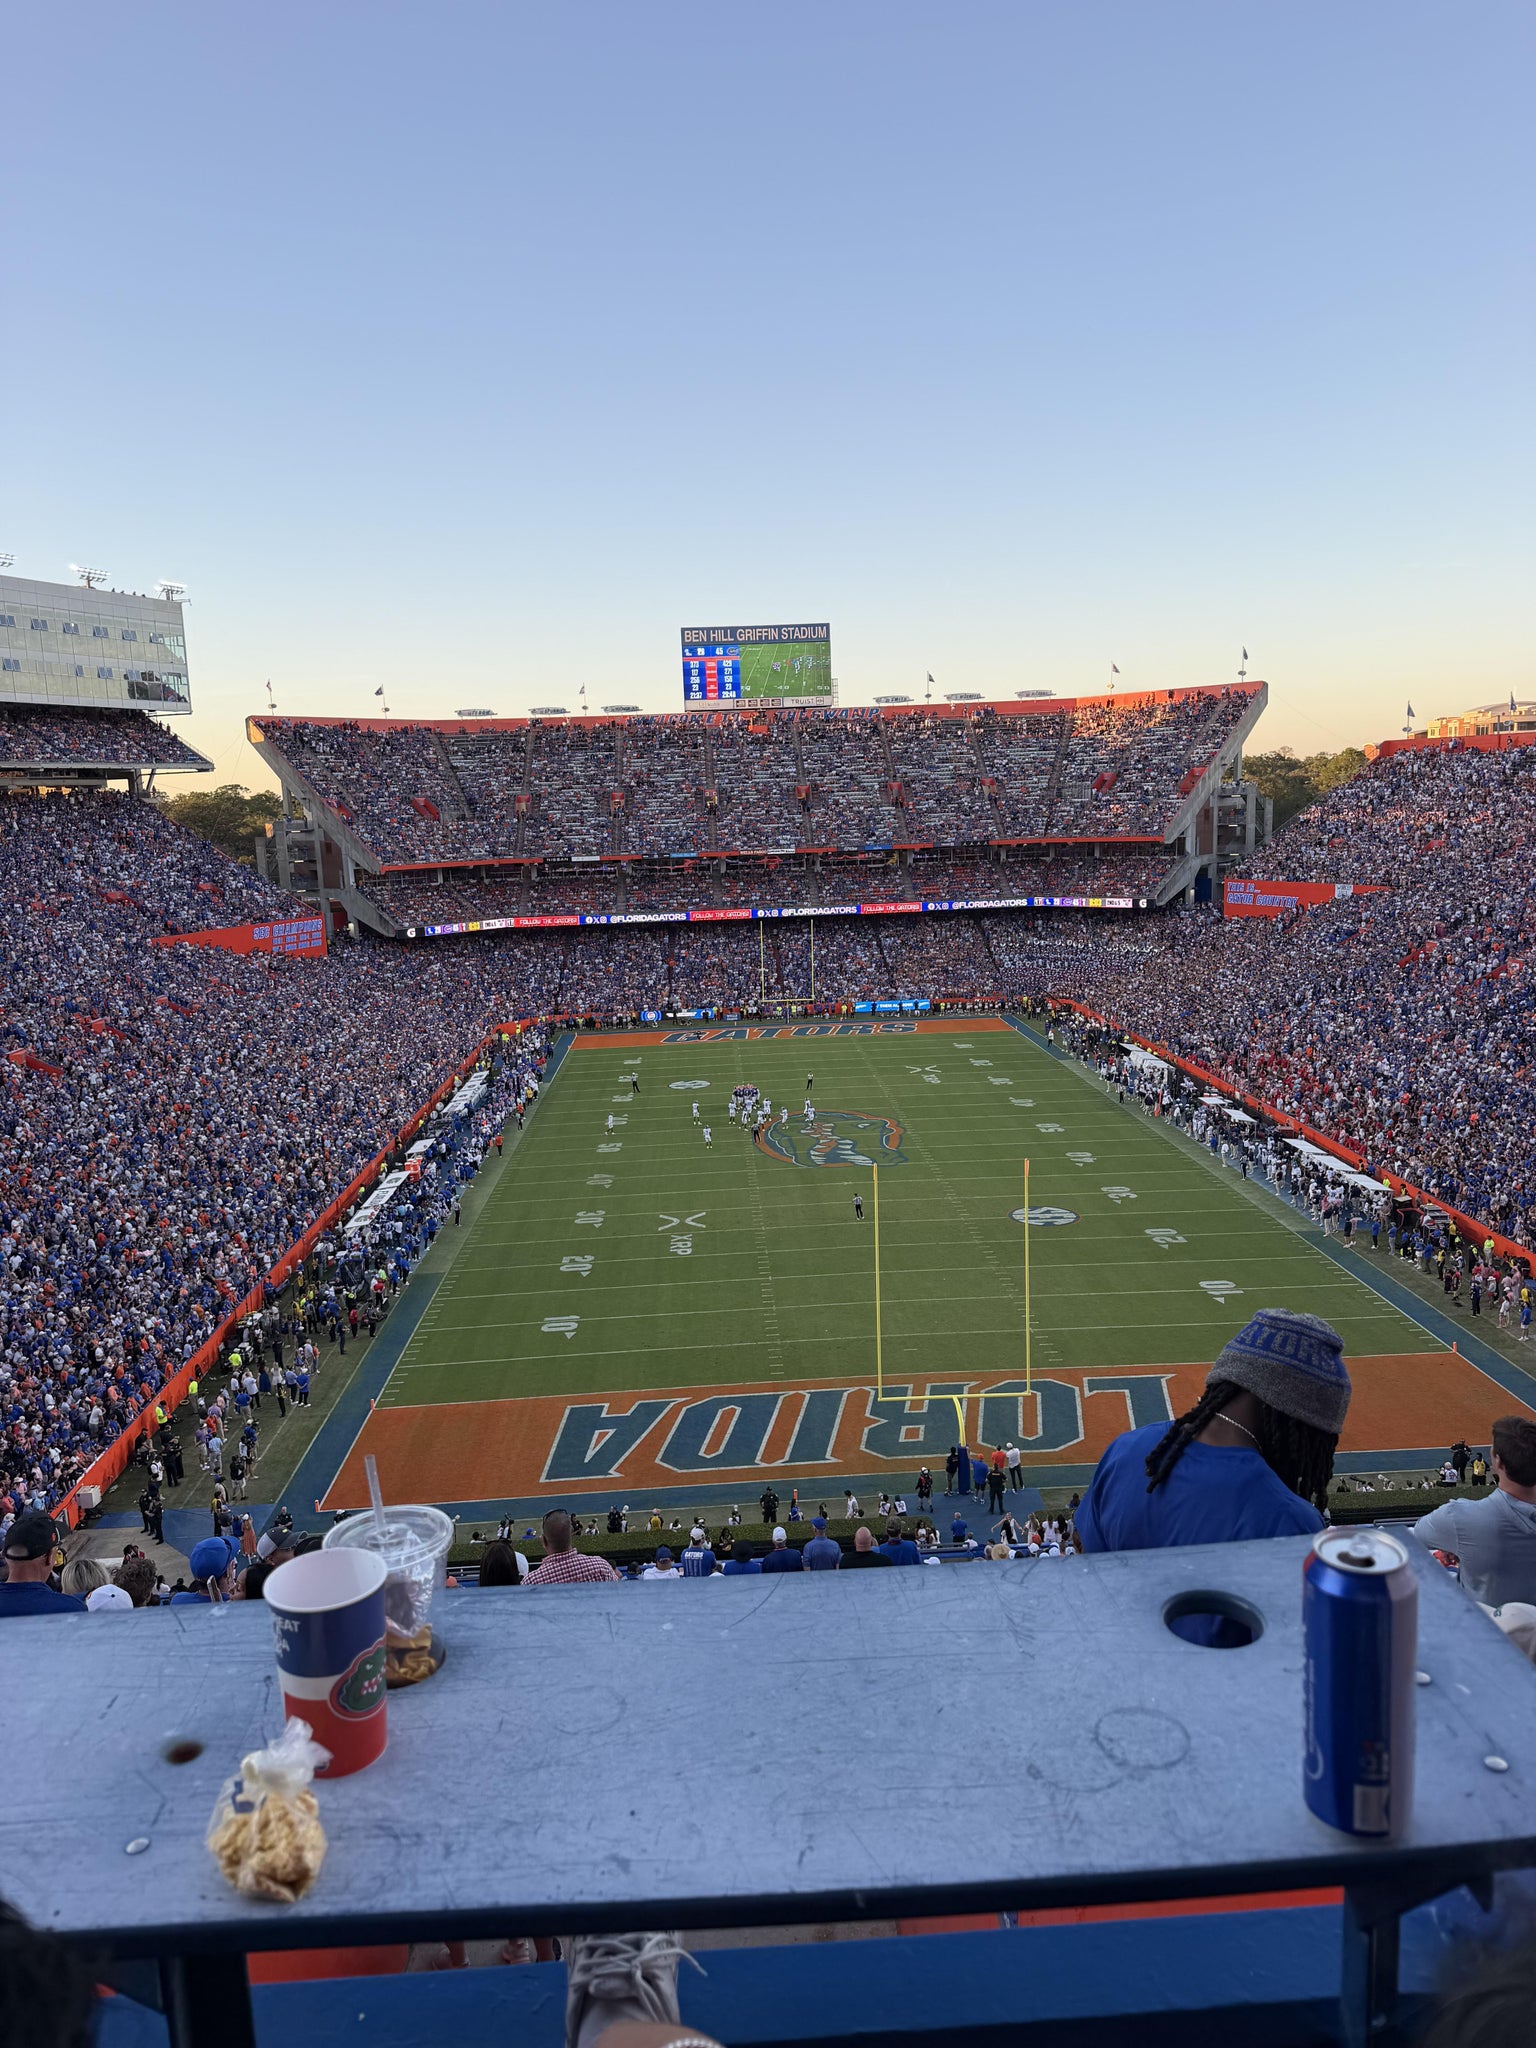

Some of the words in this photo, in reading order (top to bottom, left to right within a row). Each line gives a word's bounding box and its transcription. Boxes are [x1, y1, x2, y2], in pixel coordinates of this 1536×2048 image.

[684, 630, 706, 642] BEN
[710, 629, 734, 642] HILL
[736, 628, 778, 641] GRIFFIN
[782, 626, 826, 639] STADIUM
[627, 713, 717, 725] WELCOME
[777, 710, 808, 721] THE
[811, 708, 880, 720] SWAMP
[952, 899, 1027, 910] @FLORIDAGATORS
[1227, 892, 1252, 905] GATOR
[1256, 895, 1299, 908] COUNTRY
[610, 913, 687, 924] @FLORIDAGATORS
[782, 906, 857, 917] @FLORIDAGATORS
[253, 926, 270, 940] SEC
[272, 919, 322, 936] CHAMPIONS
[661, 1022, 918, 1043] GATORS
[1036, 1123, 1065, 1133] 50
[596, 1142, 623, 1152] 50
[1065, 1151, 1096, 1163] 40
[586, 1174, 615, 1186] 40
[1100, 1186, 1137, 1199] 30
[574, 1210, 606, 1224] 30
[670, 1234, 692, 1255] XRP
[1144, 1228, 1188, 1245] 20
[560, 1255, 595, 1272] 20
[1198, 1280, 1244, 1295] 10
[540, 1315, 581, 1332] 10
[1237, 1325, 1337, 1372] ATORS
[540, 1374, 1176, 1482] LORIDA
